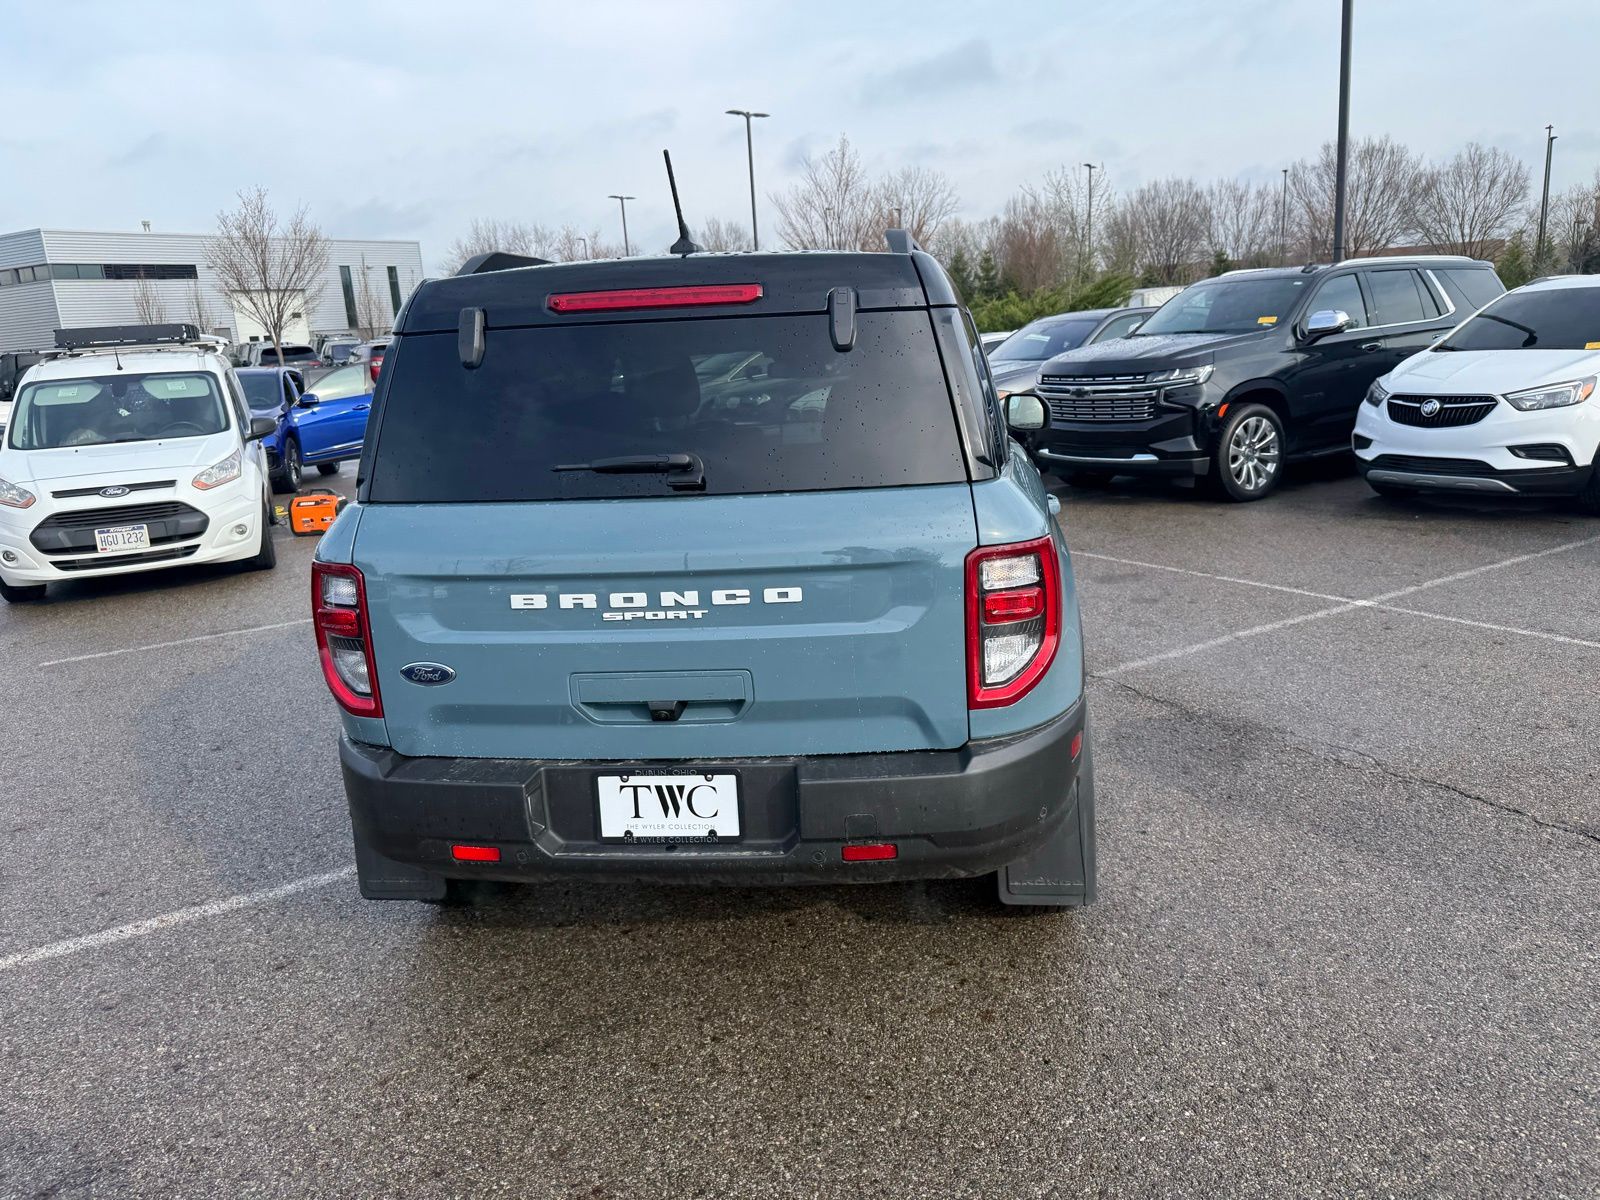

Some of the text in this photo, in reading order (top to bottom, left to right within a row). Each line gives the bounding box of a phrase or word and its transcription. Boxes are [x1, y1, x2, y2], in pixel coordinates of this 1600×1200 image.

[99, 531, 145, 547] HGU 1232
[510, 587, 803, 609] BRONCO
[602, 610, 709, 621] SPORT
[412, 666, 442, 681] Ford
[619, 784, 719, 819] TWC
[624, 835, 719, 844] THE WYLER COLLECTION
